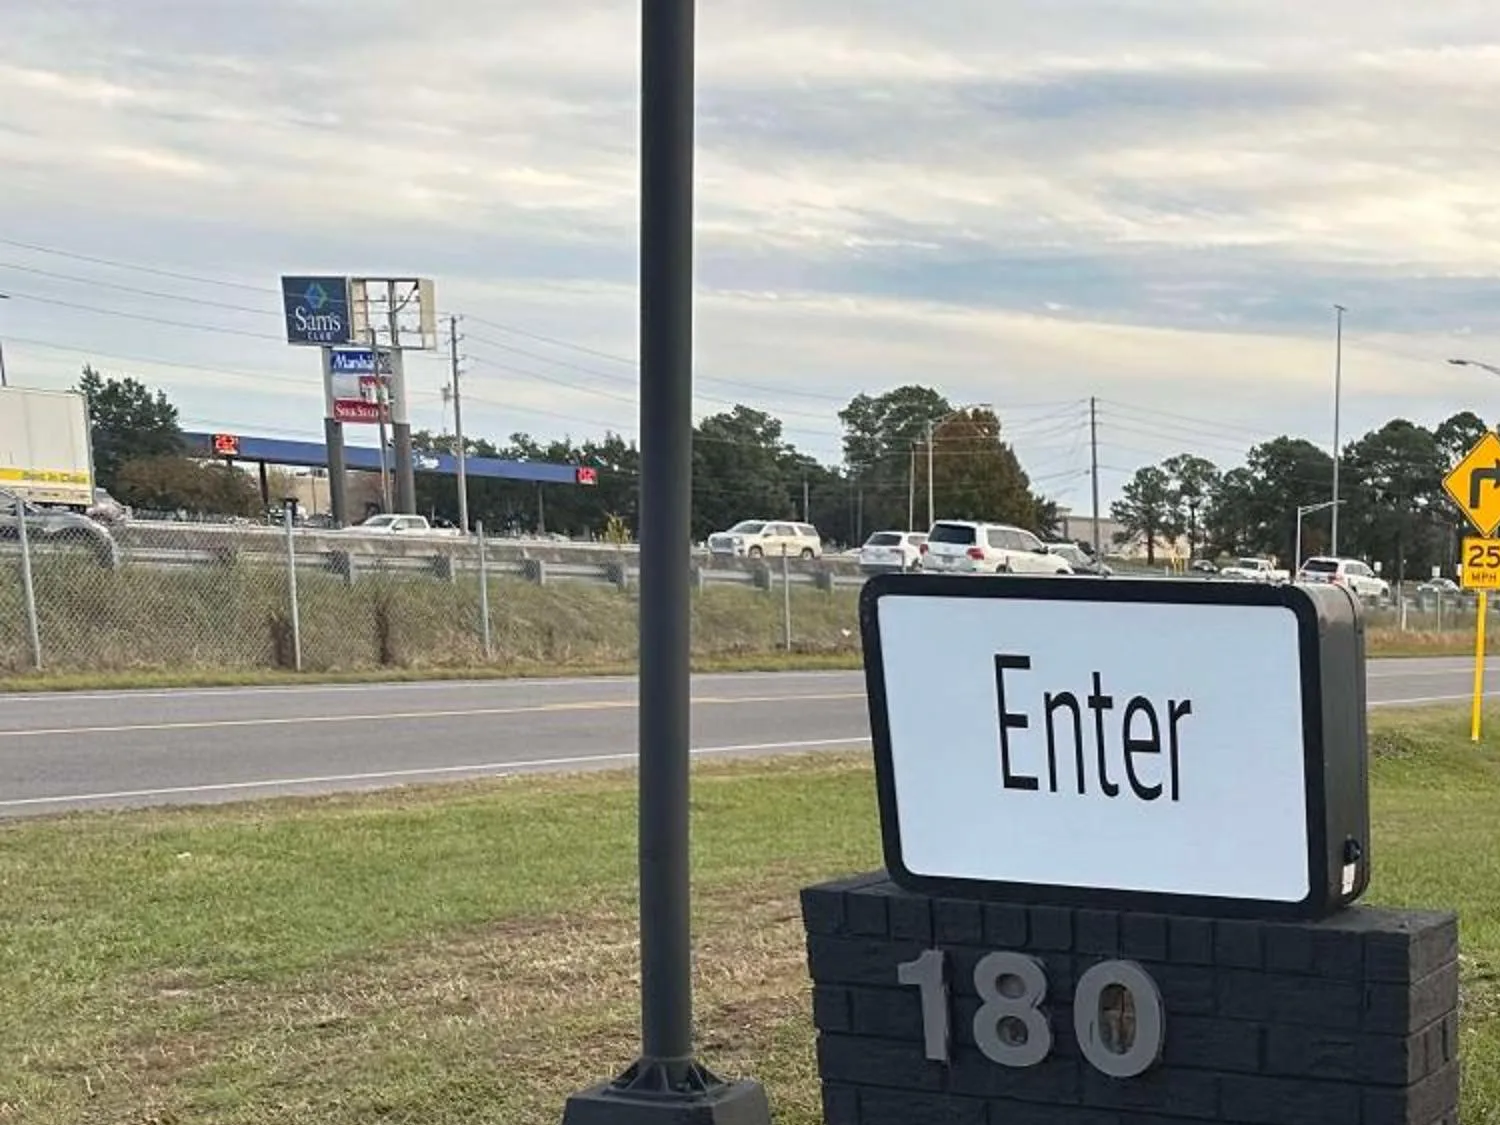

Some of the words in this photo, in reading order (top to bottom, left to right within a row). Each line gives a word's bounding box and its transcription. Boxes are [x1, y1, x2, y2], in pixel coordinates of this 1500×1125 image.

[295, 306, 341, 332] Sam's
[1468, 545, 1500, 568] 25
[1471, 573, 1497, 583] MPH
[993, 652, 1193, 803] Enter
[898, 949, 1166, 1078] 180
